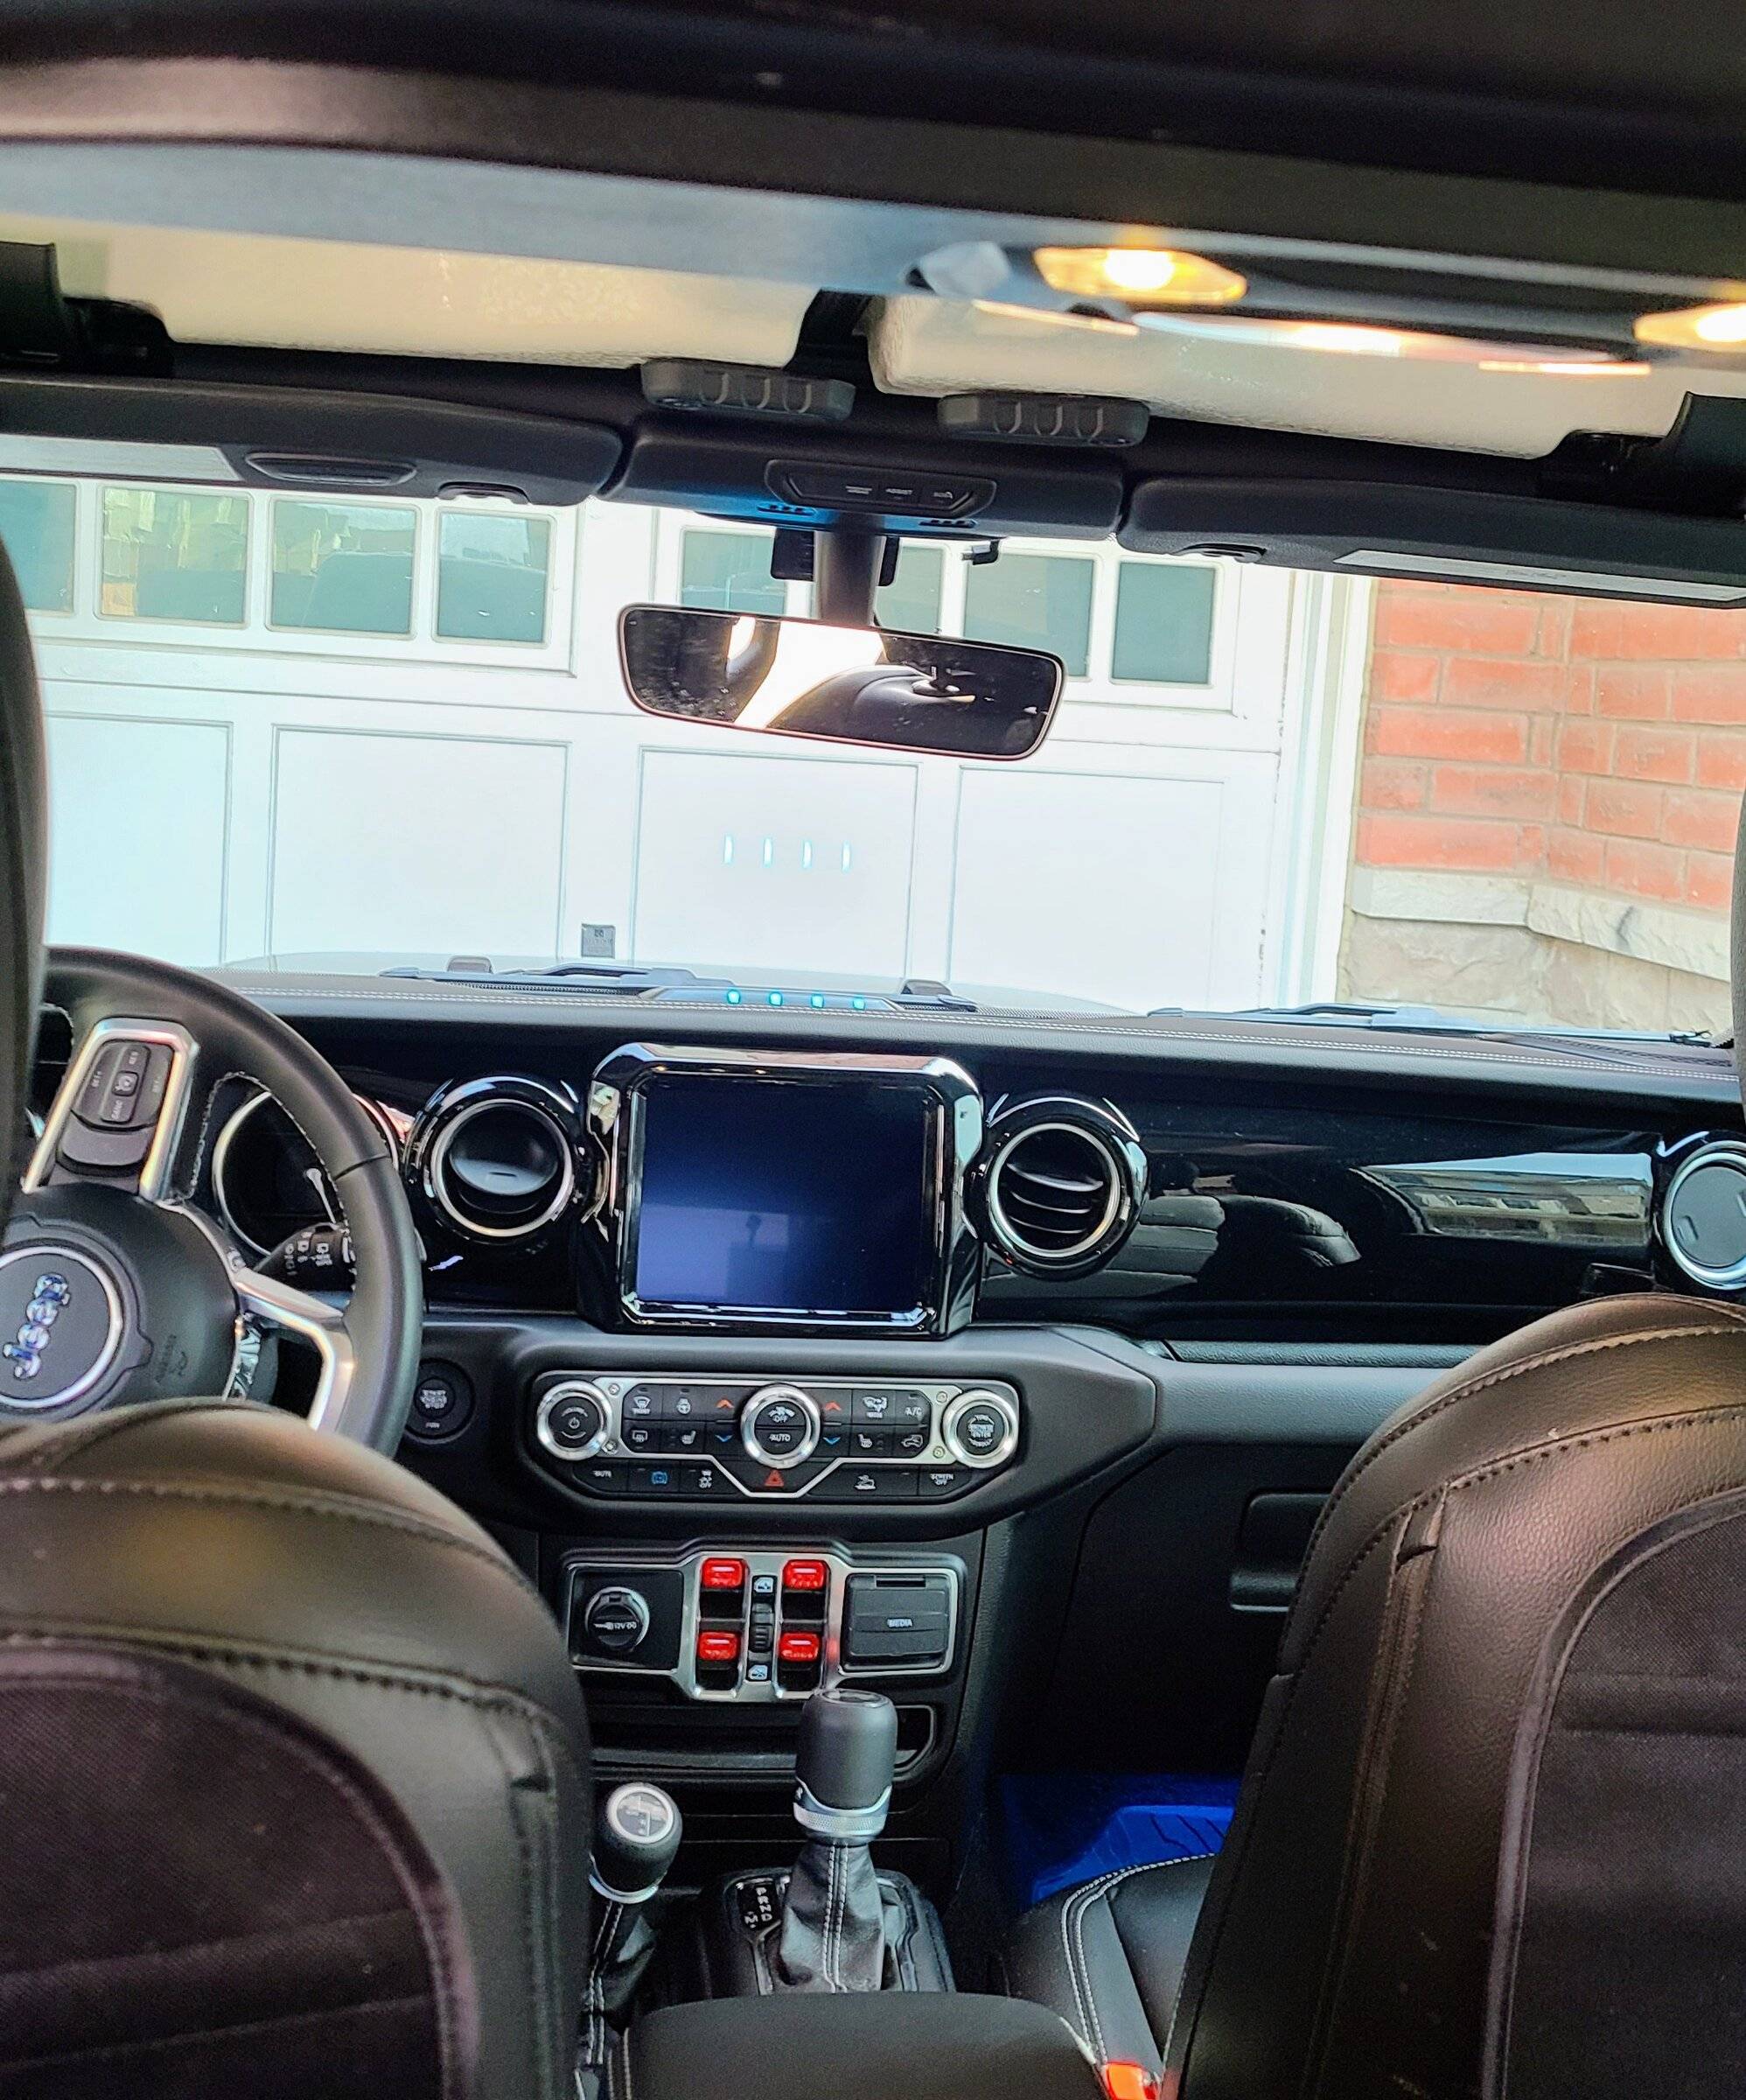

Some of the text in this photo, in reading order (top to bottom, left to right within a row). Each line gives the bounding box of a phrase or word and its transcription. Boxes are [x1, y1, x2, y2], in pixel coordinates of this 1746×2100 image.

[3, 1271, 70, 1379] Jeep
[904, 1407, 923, 1417] A/C
[769, 1433, 791, 1442] AUTO
